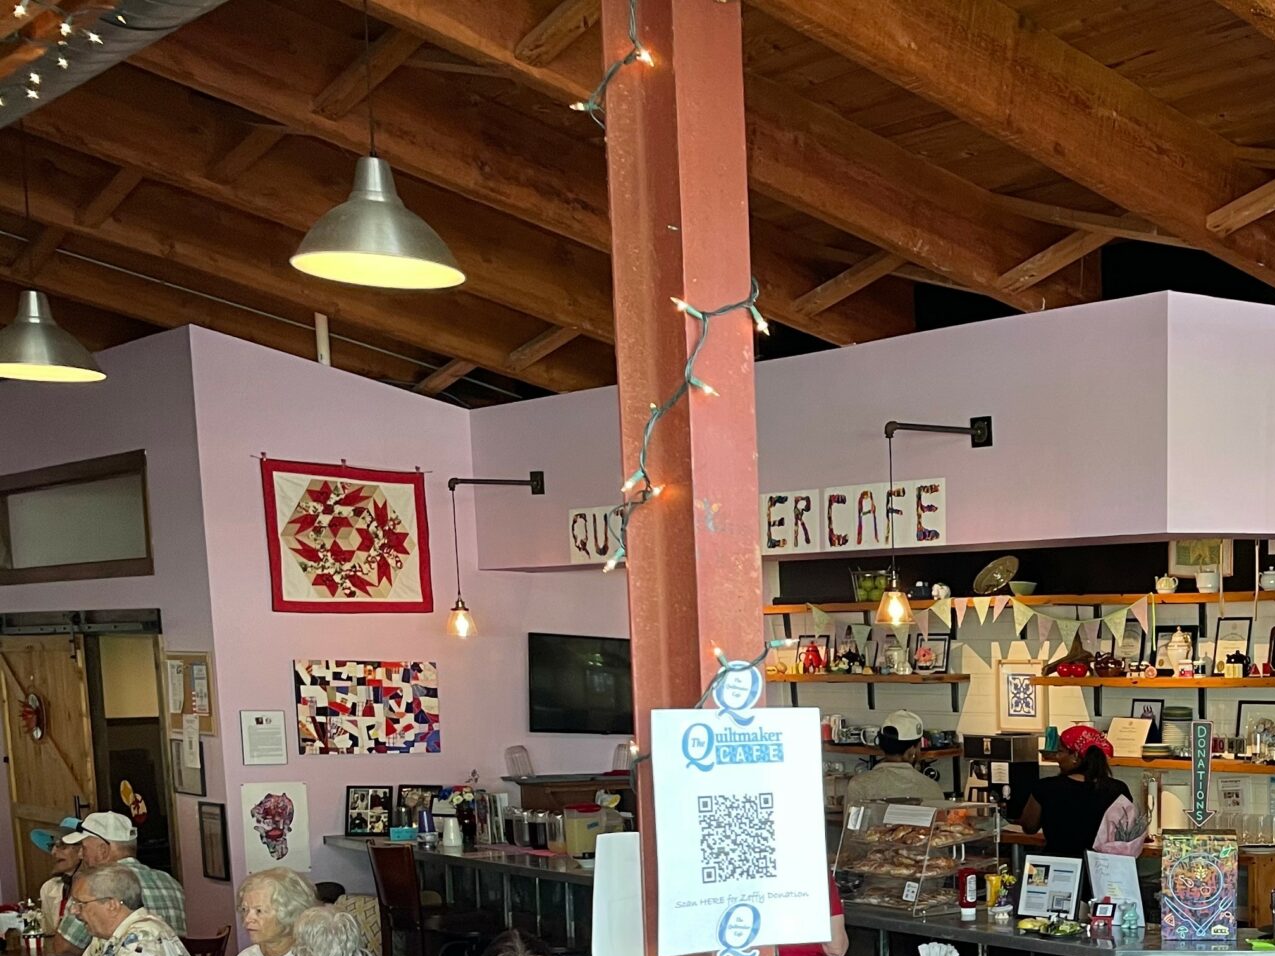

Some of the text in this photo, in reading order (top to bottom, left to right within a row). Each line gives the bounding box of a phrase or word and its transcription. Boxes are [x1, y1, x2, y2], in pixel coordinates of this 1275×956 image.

[827, 484, 940, 546] CAFE
[691, 738, 705, 748] The
[719, 745, 779, 762] CAFE
[1196, 725, 1207, 821] DONATIONS
[675, 900, 698, 909] Scan
[699, 896, 725, 905] HERE
[727, 894, 739, 905] for
[767, 890, 810, 899] Donation
